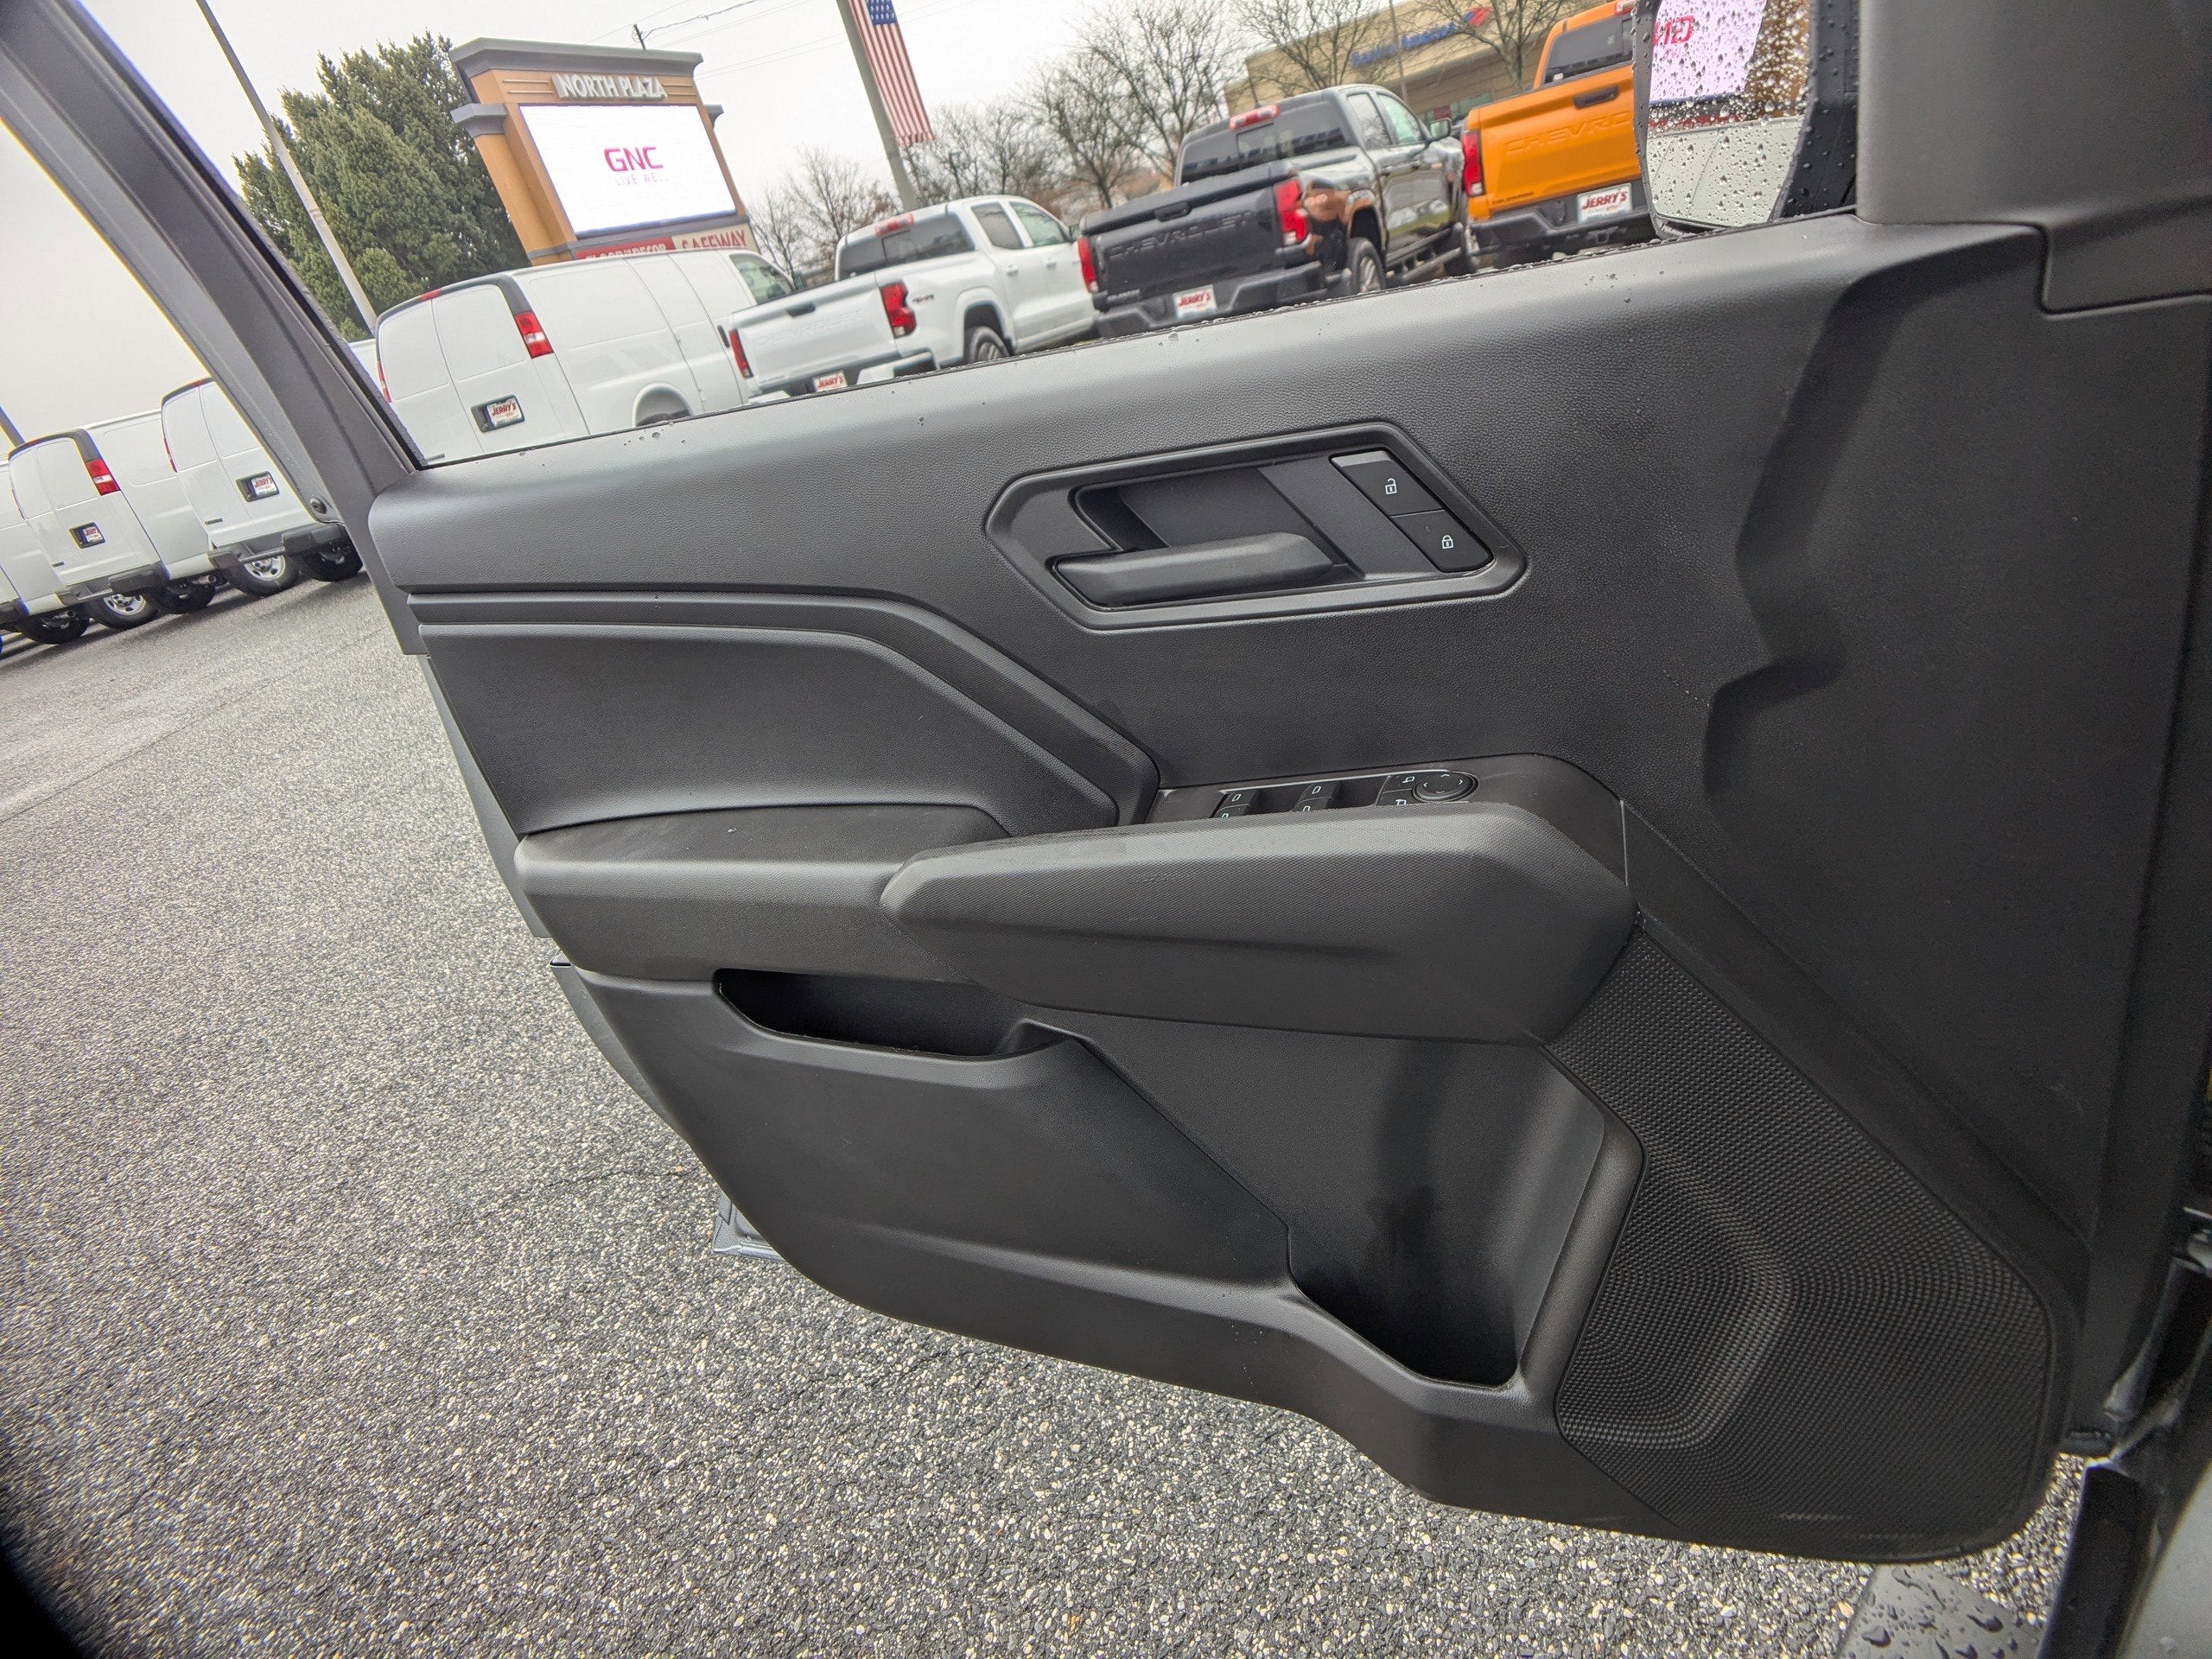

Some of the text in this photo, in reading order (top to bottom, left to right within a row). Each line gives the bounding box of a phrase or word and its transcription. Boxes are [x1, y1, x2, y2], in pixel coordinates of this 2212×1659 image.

[550, 73, 668, 99] NORTH PLAZA
[603, 146, 664, 172] GNC
[1582, 191, 1628, 211] JERRY'S
[1109, 209, 1253, 261] CHEVROLET
[492, 401, 517, 416] JERRY'S
